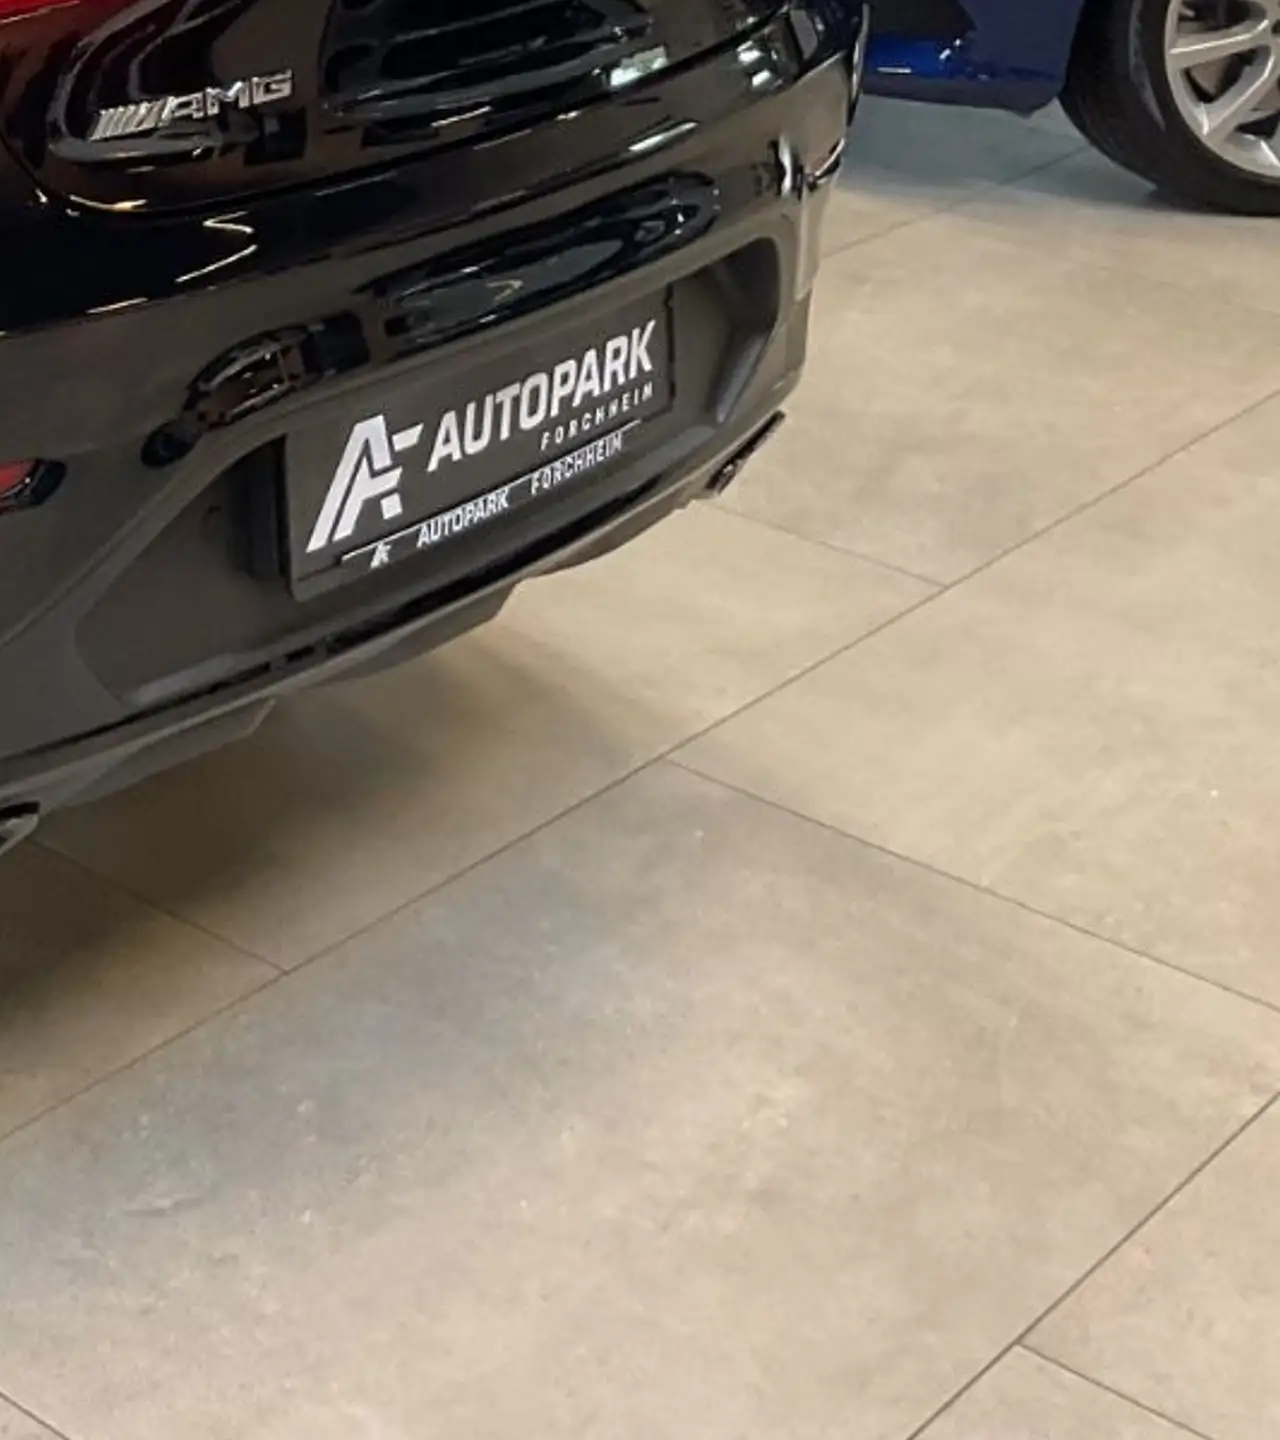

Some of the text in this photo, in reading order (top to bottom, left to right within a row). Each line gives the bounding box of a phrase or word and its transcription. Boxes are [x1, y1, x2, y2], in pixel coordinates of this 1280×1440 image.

[159, 69, 292, 128] AMG
[426, 319, 656, 472] AUTOPARK
[540, 381, 654, 451] FORCHHEIM
[416, 432, 624, 548] AUTOPARK FORCHHEIM
